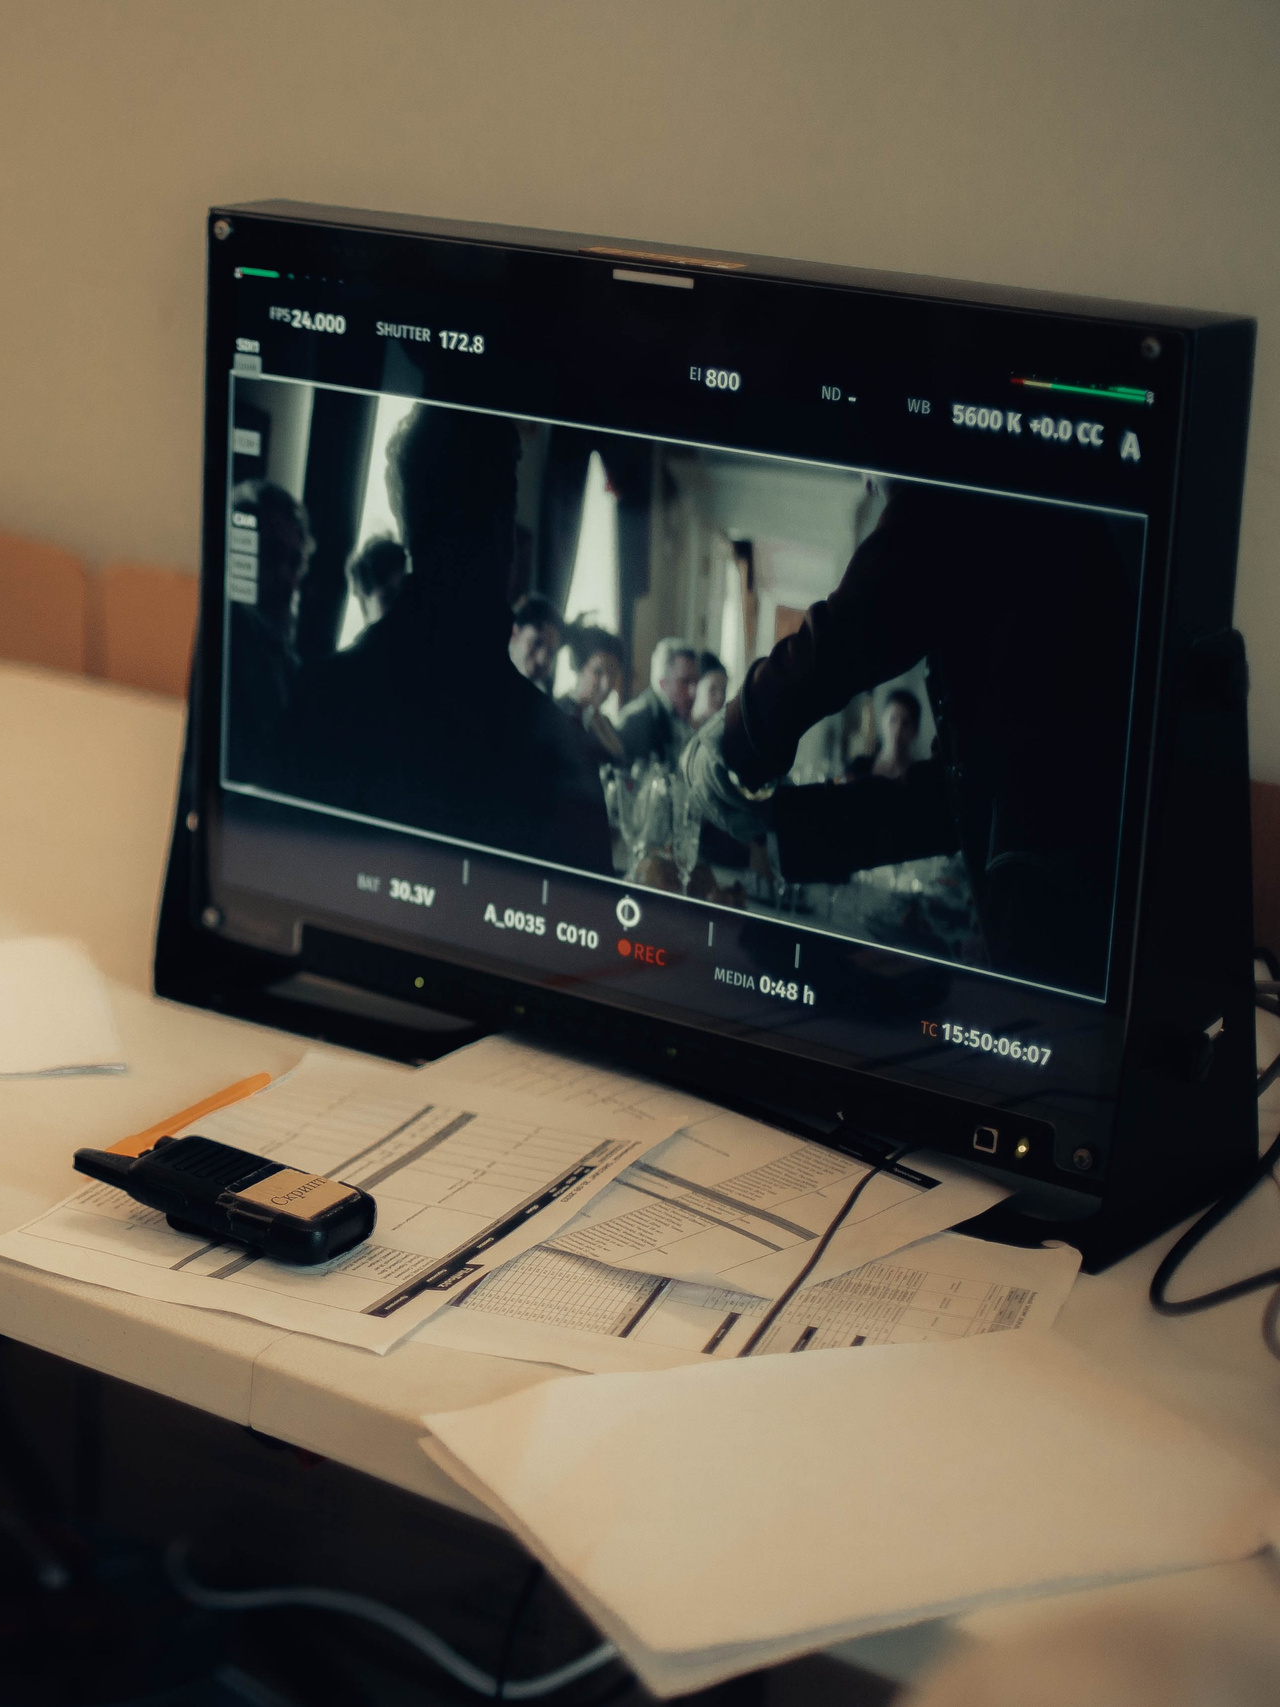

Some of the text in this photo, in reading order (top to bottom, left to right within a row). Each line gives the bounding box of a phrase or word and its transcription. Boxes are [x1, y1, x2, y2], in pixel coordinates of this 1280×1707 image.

[269, 306, 347, 335] FPS 24.000
[376, 321, 485, 355] SHUTTER 172.8
[689, 366, 741, 392] EI 800
[821, 386, 842, 402] ND
[907, 398, 1105, 447] WB 5600 K +0.0 CC
[1121, 432, 1141, 462] A
[389, 877, 436, 908] 30.3V
[484, 903, 599, 950] A_0035 C010
[633, 943, 666, 967] REC
[714, 966, 815, 1006] MEDIA 0:48 h
[921, 1020, 1052, 1067] TC 15:50:06:07
[270, 1177, 327, 1206] Скрипт
